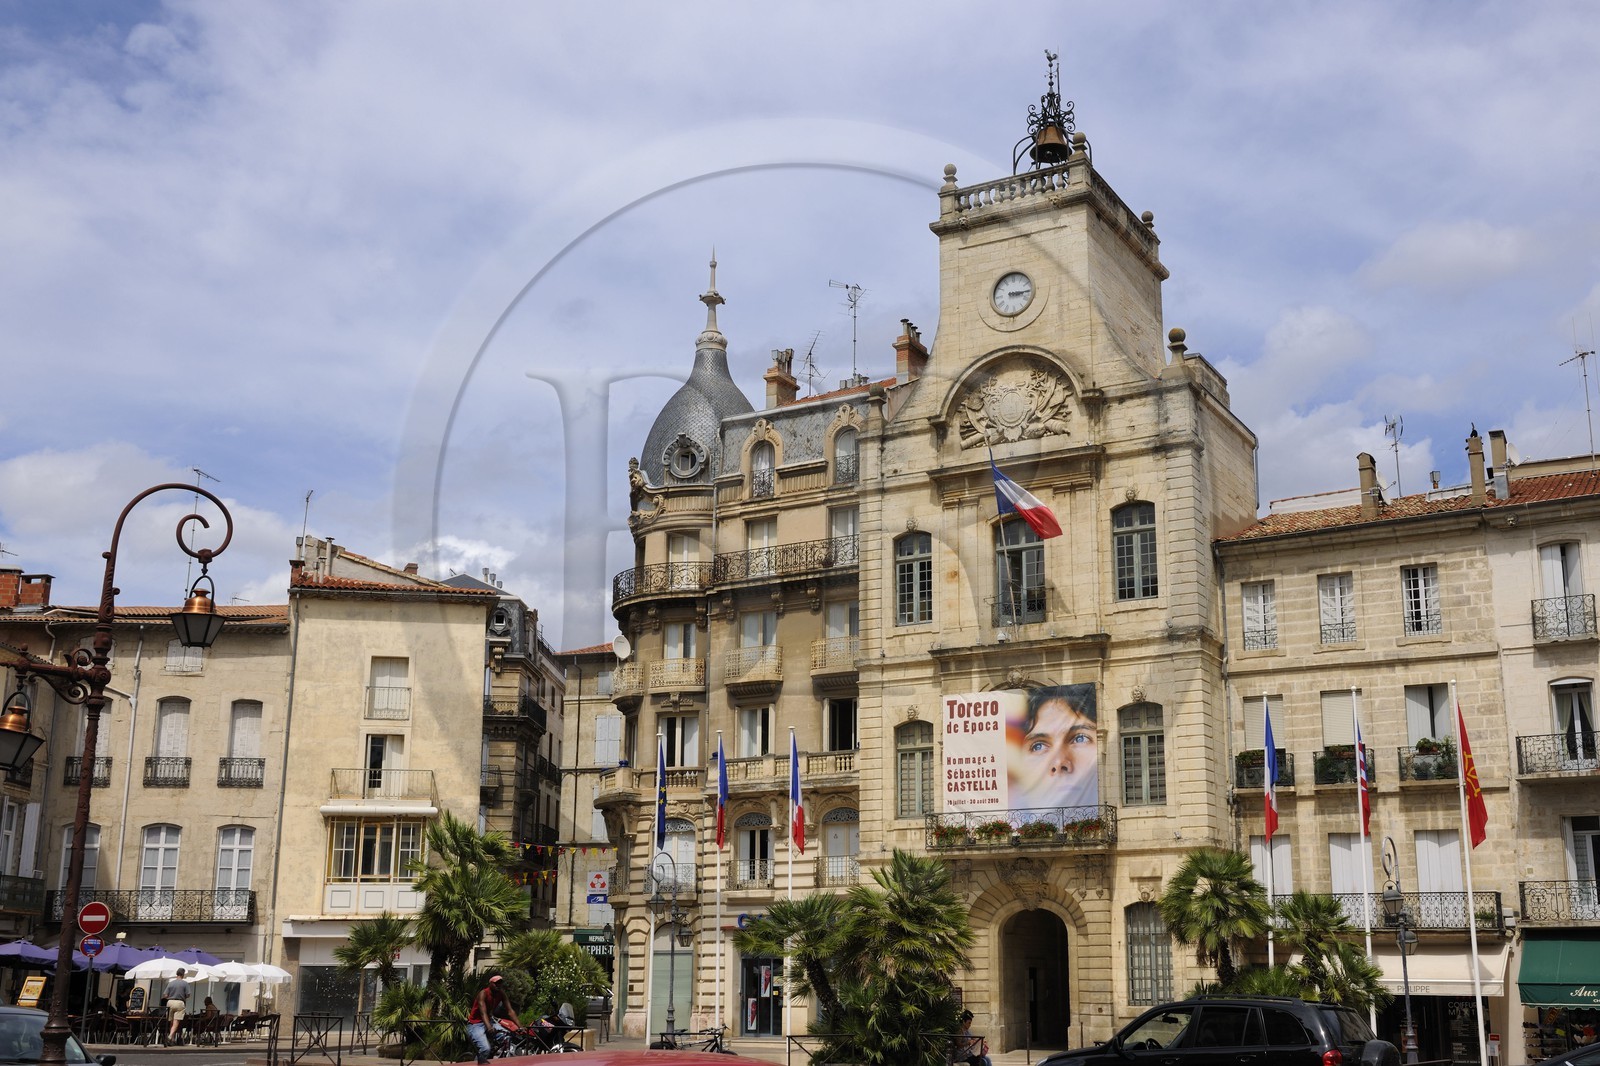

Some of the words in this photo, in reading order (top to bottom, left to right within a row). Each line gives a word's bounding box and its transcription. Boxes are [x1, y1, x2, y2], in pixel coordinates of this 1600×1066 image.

[946, 700, 999, 719] Torero
[946, 721, 959, 734] de
[964, 721, 999, 734] Epoca
[946, 755, 987, 766] Hommage
[990, 753, 996, 763] à
[946, 768, 997, 780] Sébastien
[947, 780, 997, 792] CASTELLA
[1570, 985, 1599, 997] Aux
